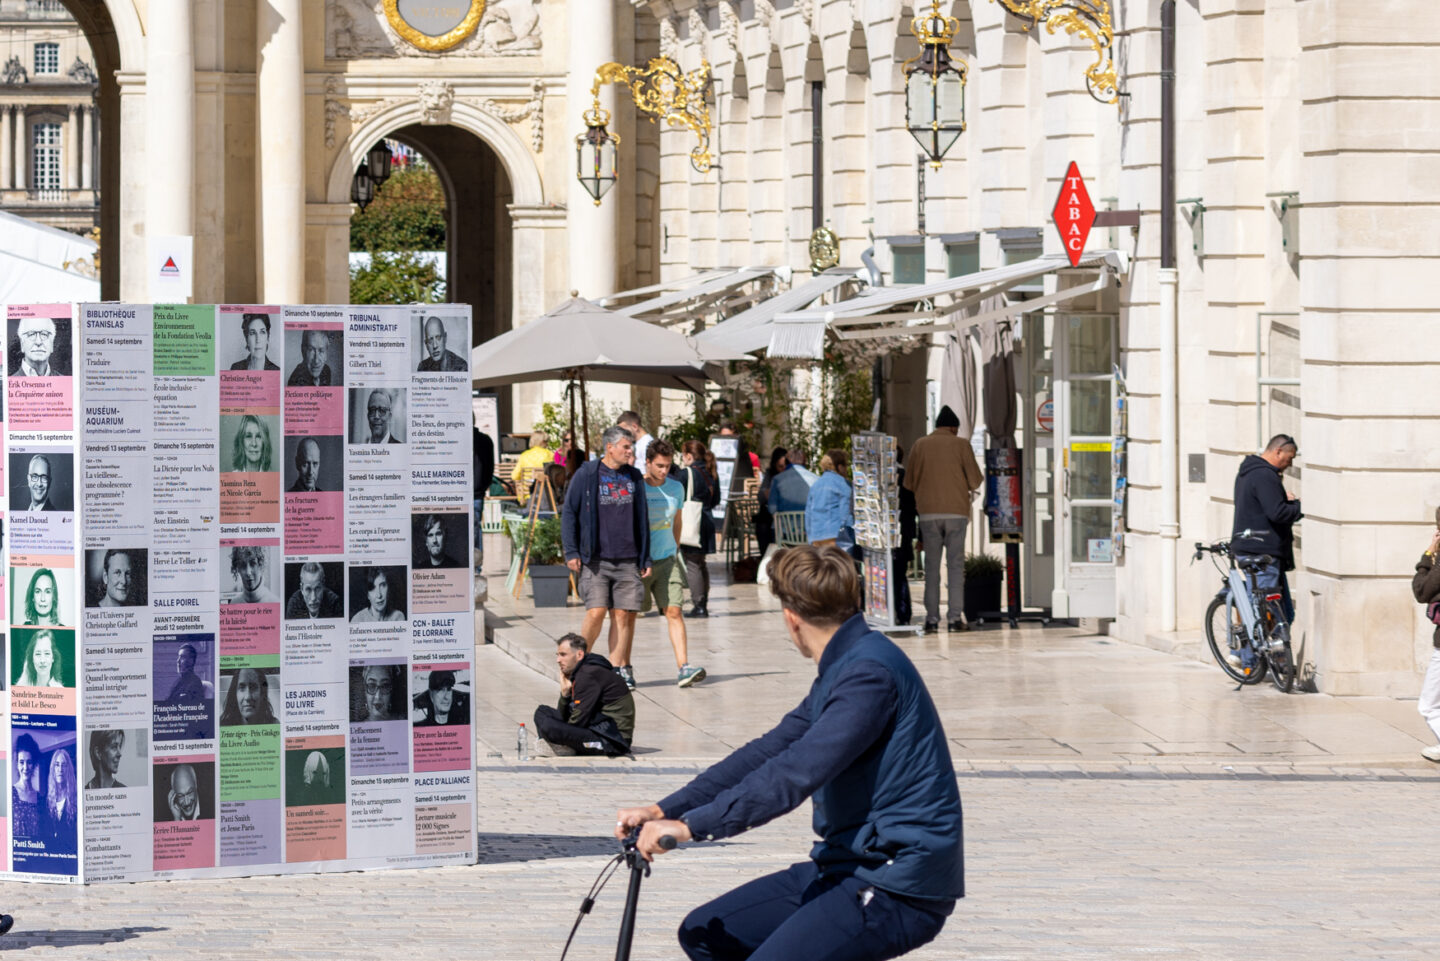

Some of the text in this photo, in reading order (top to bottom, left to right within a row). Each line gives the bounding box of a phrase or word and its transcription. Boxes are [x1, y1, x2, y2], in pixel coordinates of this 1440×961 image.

[1068, 177, 1082, 250] TABAC
[87, 309, 136, 319] BIBLIOTHÈQUE
[86, 406, 120, 415] MUSÉUM-
[154, 614, 200, 623] AVANT-PREMIÈRE
[177, 623, 204, 632] septembre
[382, 777, 409, 786] septembre
[435, 776, 470, 785] D'ALLIANCE
